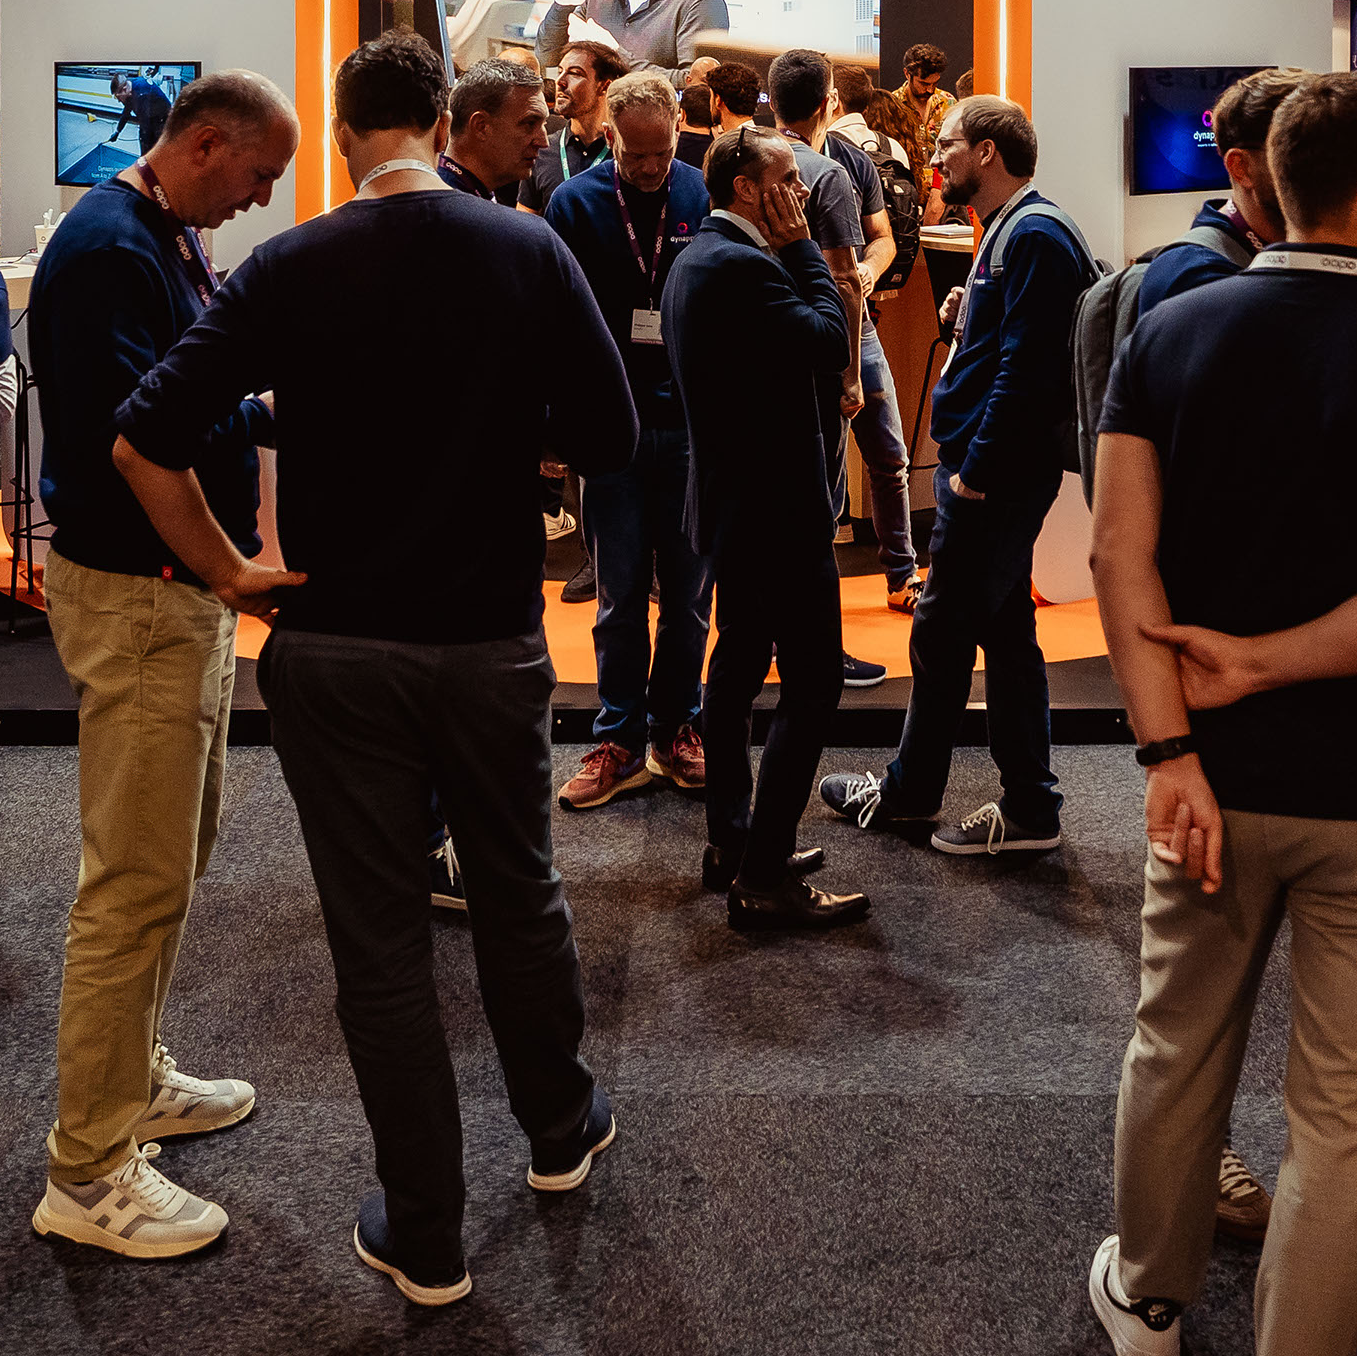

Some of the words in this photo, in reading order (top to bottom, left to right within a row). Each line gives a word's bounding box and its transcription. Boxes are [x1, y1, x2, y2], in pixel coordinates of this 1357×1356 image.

[445, 161, 462, 175] odoo
[153, 185, 170, 210] odoo
[998, 203, 1013, 219] odoo
[626, 222, 636, 240] odoo
[176, 235, 192, 261] odoo
[1321, 256, 1357, 270] odoo
